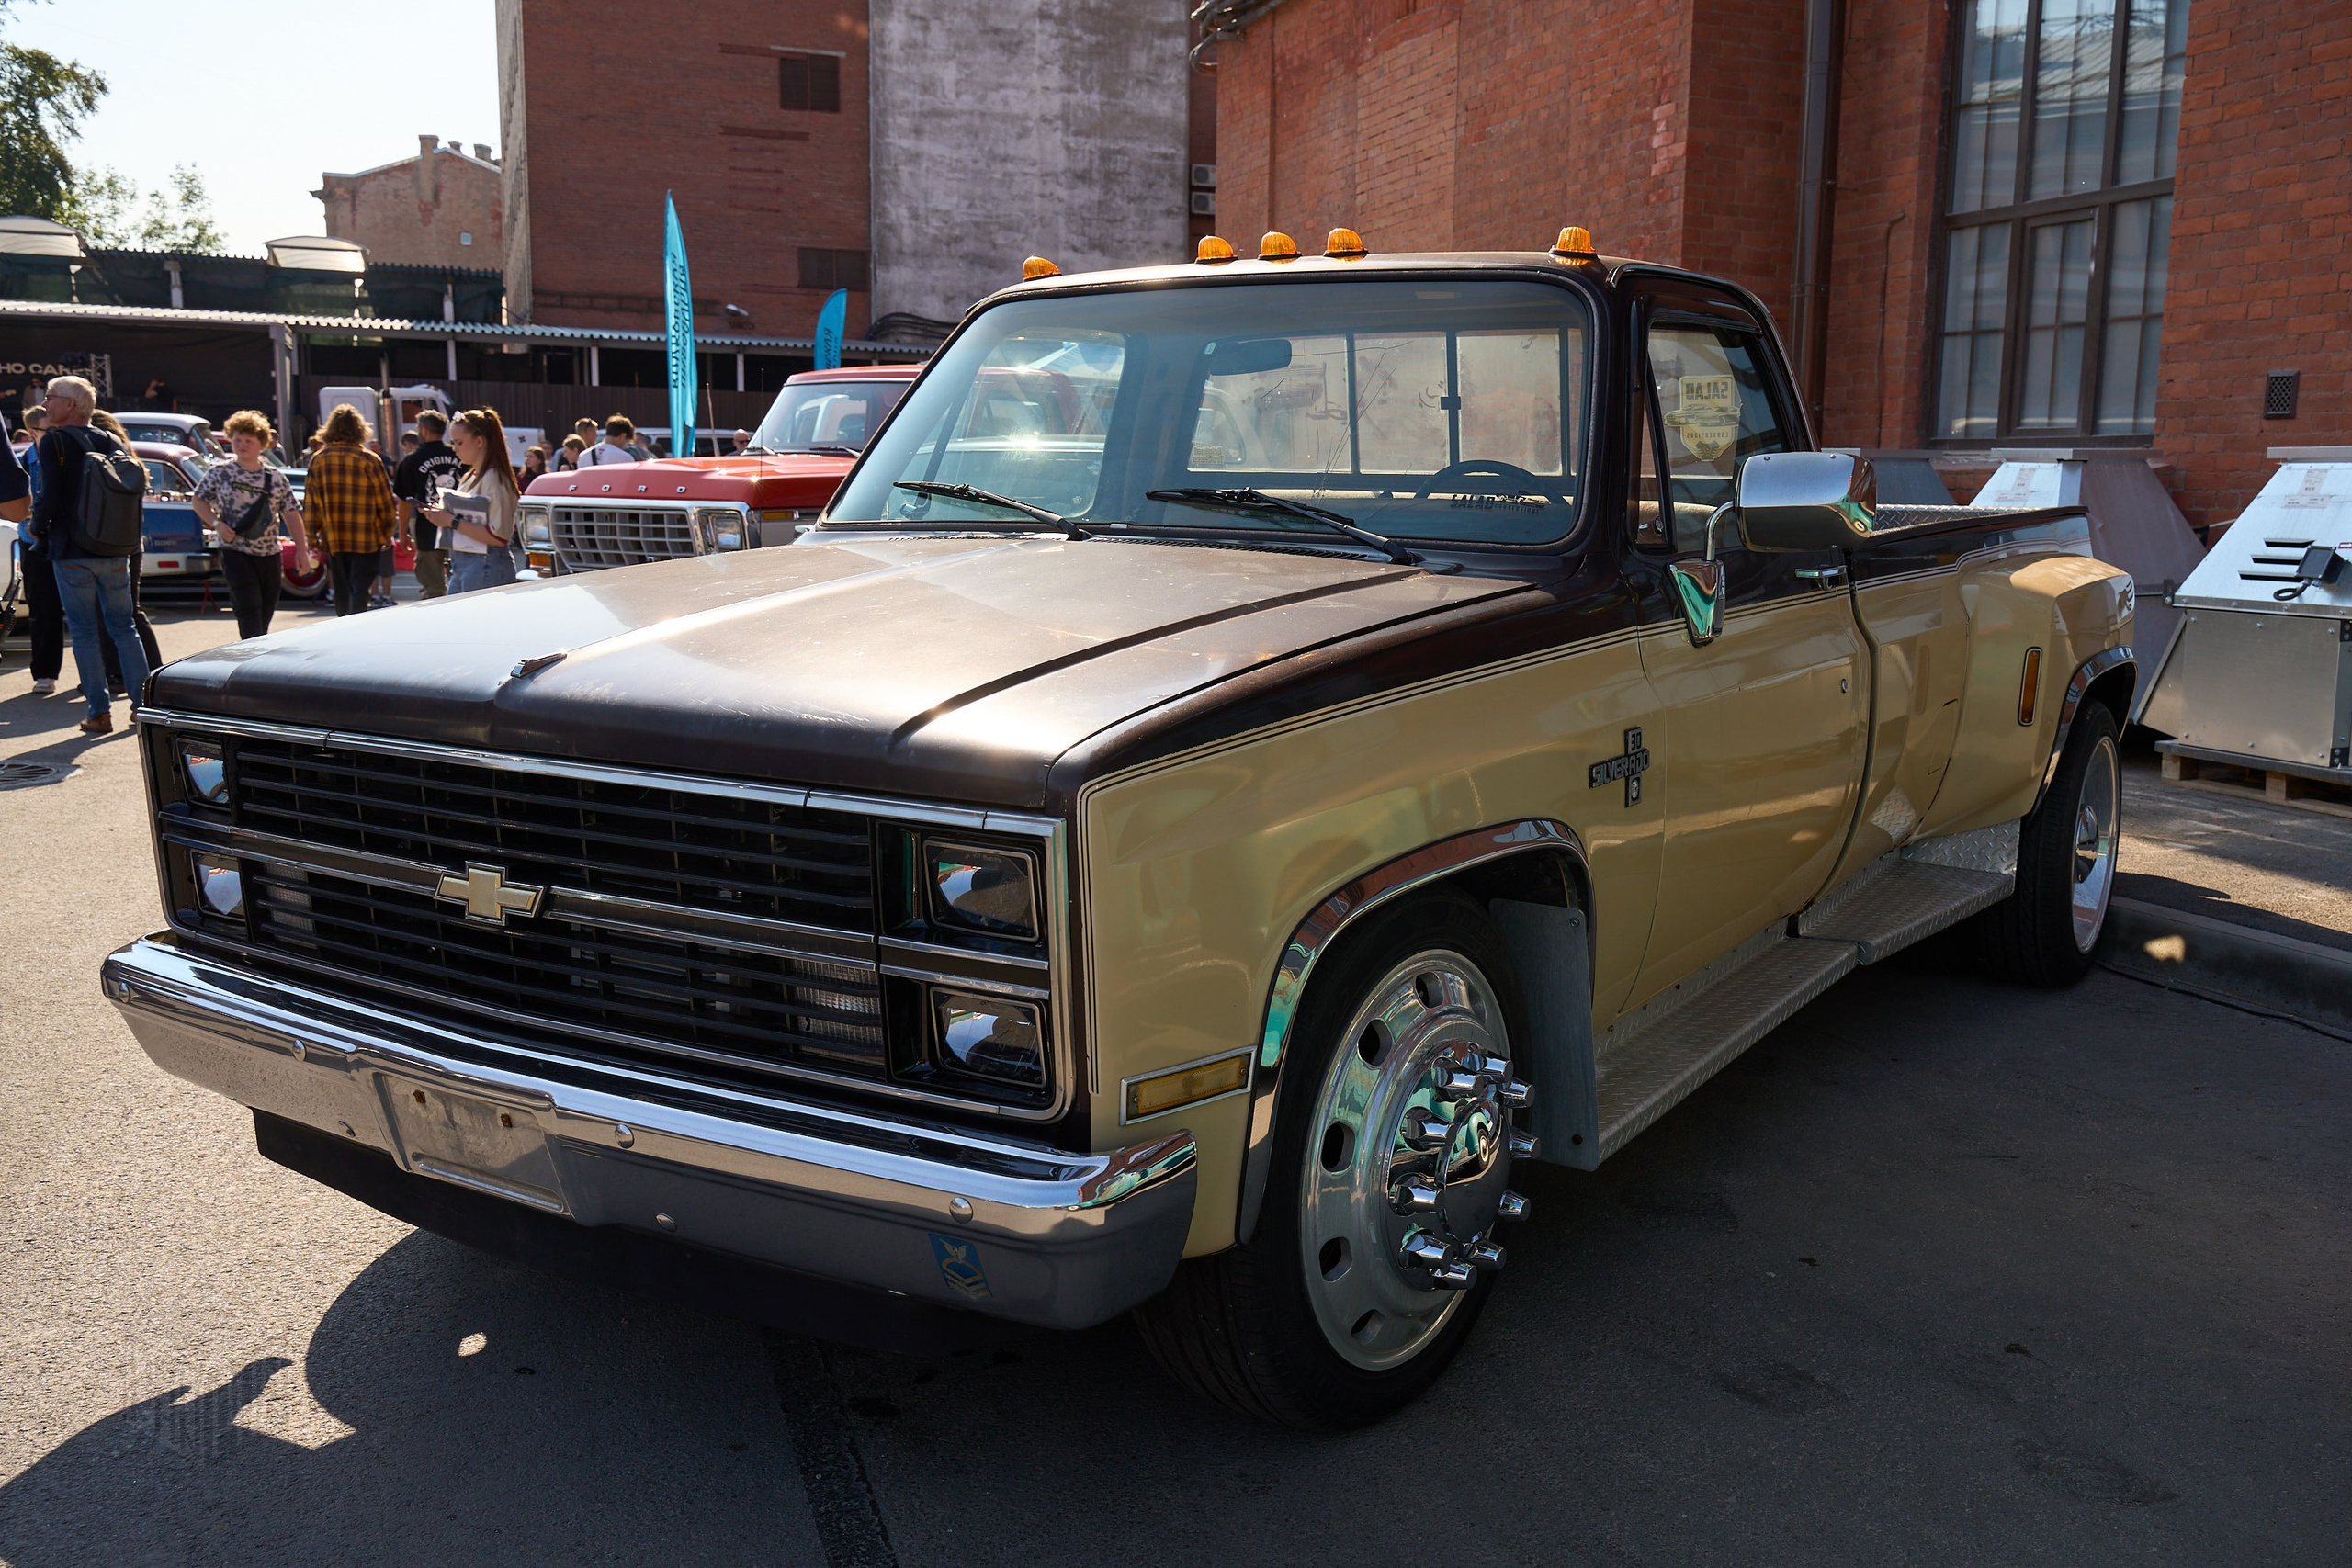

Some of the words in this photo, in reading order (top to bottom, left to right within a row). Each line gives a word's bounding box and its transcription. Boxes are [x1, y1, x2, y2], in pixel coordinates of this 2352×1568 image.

[418, 456, 463, 474] ORIGINAL
[568, 484, 687, 493] FORD
[1450, 493, 1496, 511] SALAD
[1494, 503, 1541, 514] CONVERSIONS
[1591, 749, 1650, 788] SILVERADO
